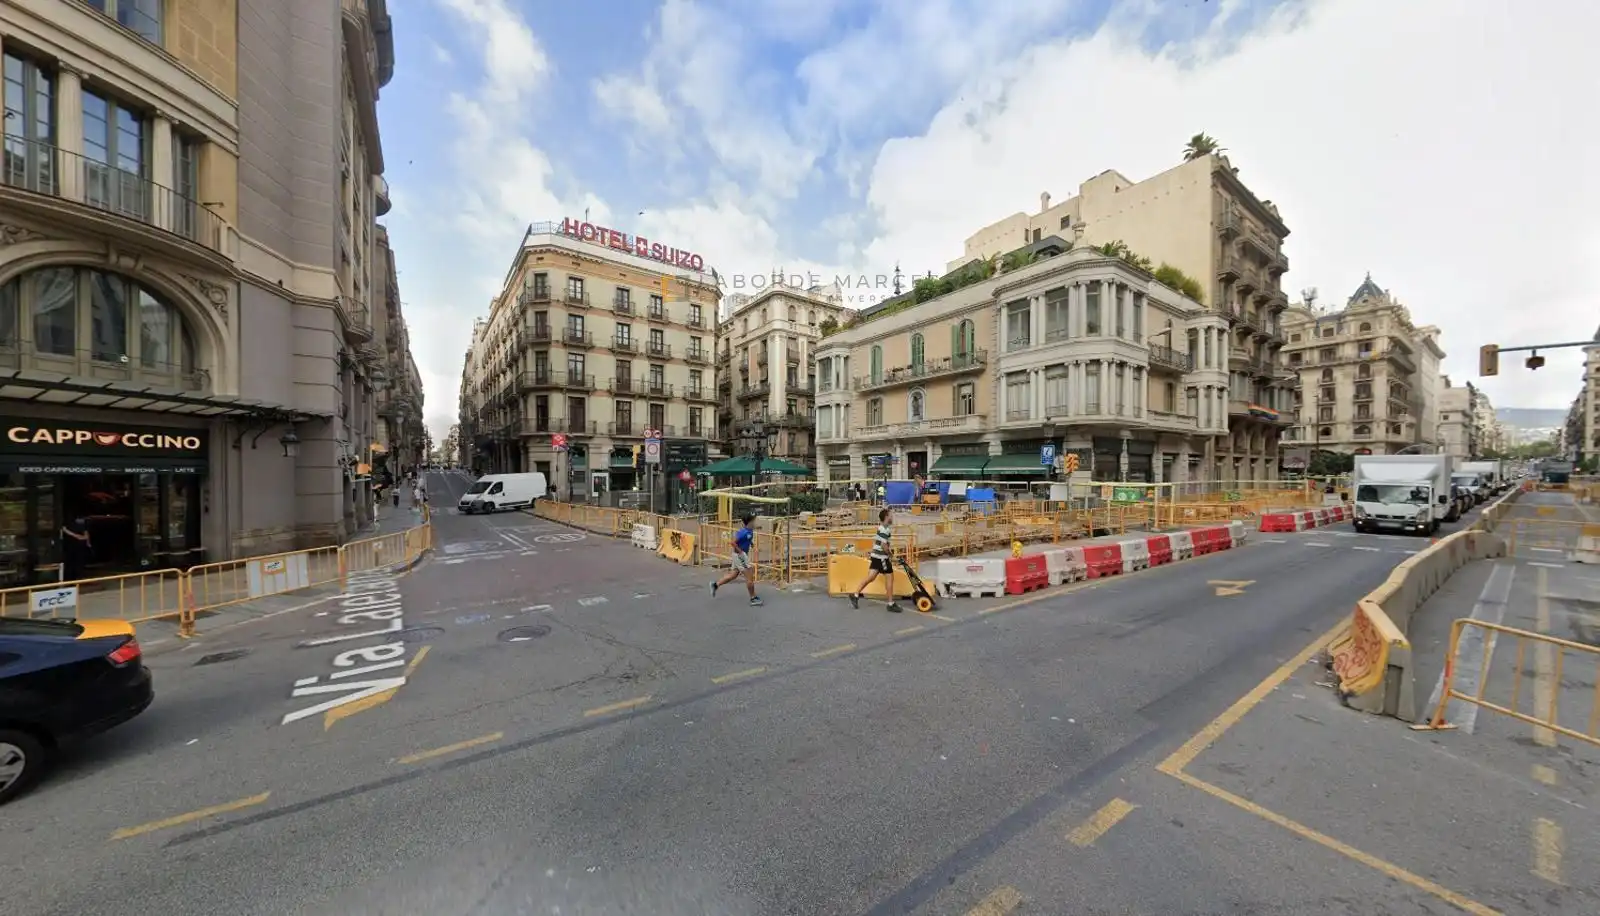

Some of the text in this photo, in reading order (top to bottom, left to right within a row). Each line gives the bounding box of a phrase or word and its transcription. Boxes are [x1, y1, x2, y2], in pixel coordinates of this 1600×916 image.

[564, 217, 704, 272] HOTEL SUIZO
[44, 466, 102, 474] CAPPUCCINO
[282, 641, 406, 725] Via
